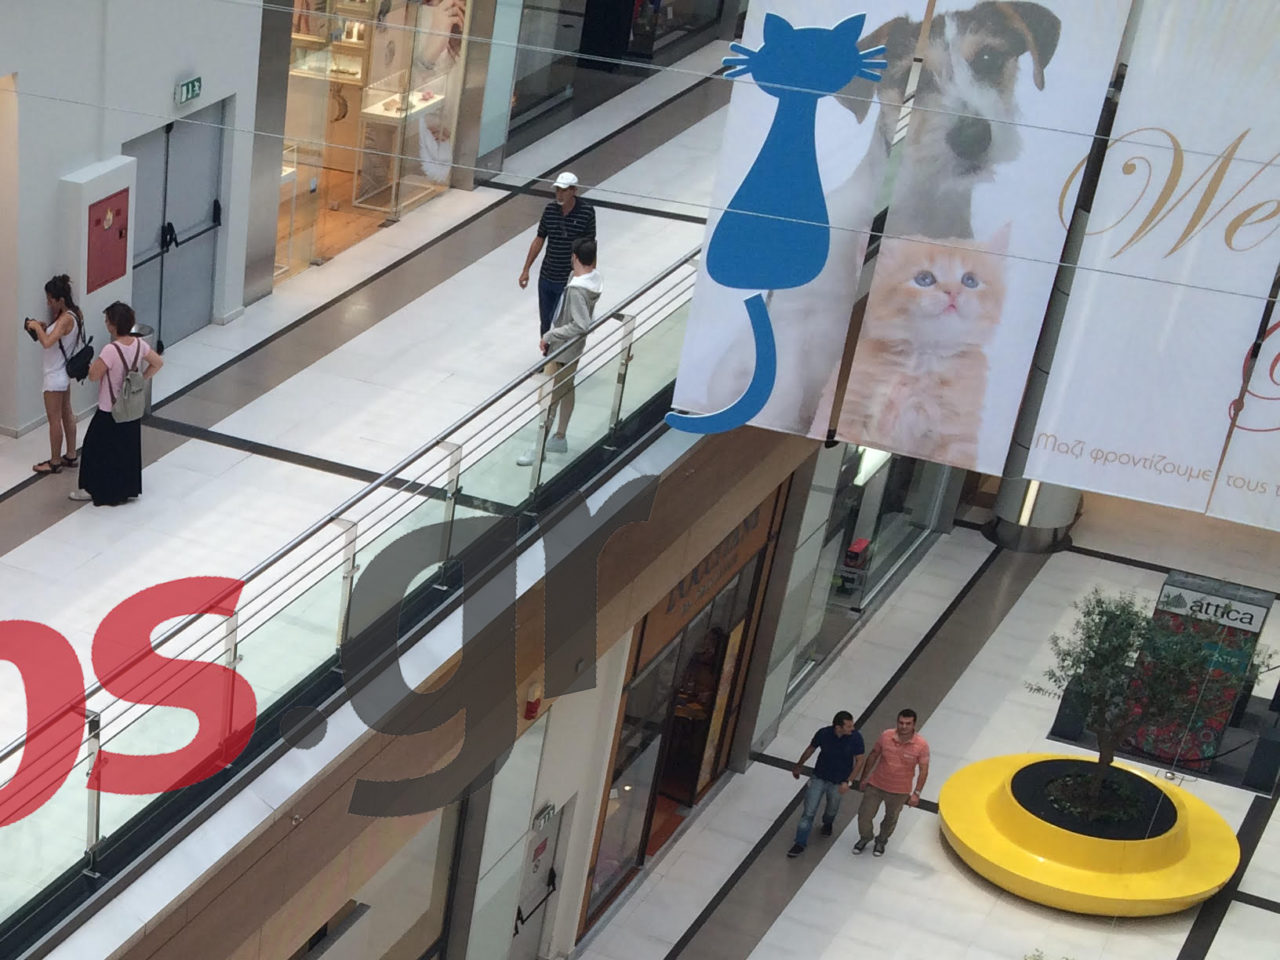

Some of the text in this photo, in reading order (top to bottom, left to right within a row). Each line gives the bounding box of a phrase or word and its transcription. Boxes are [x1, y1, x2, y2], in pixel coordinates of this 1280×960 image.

[1035, 432, 1086, 459] Μαζί
[1089, 447, 1214, 483] φροντίζουμε
[1226, 473, 1269, 494] τους
[1189, 600, 1255, 626] attica
